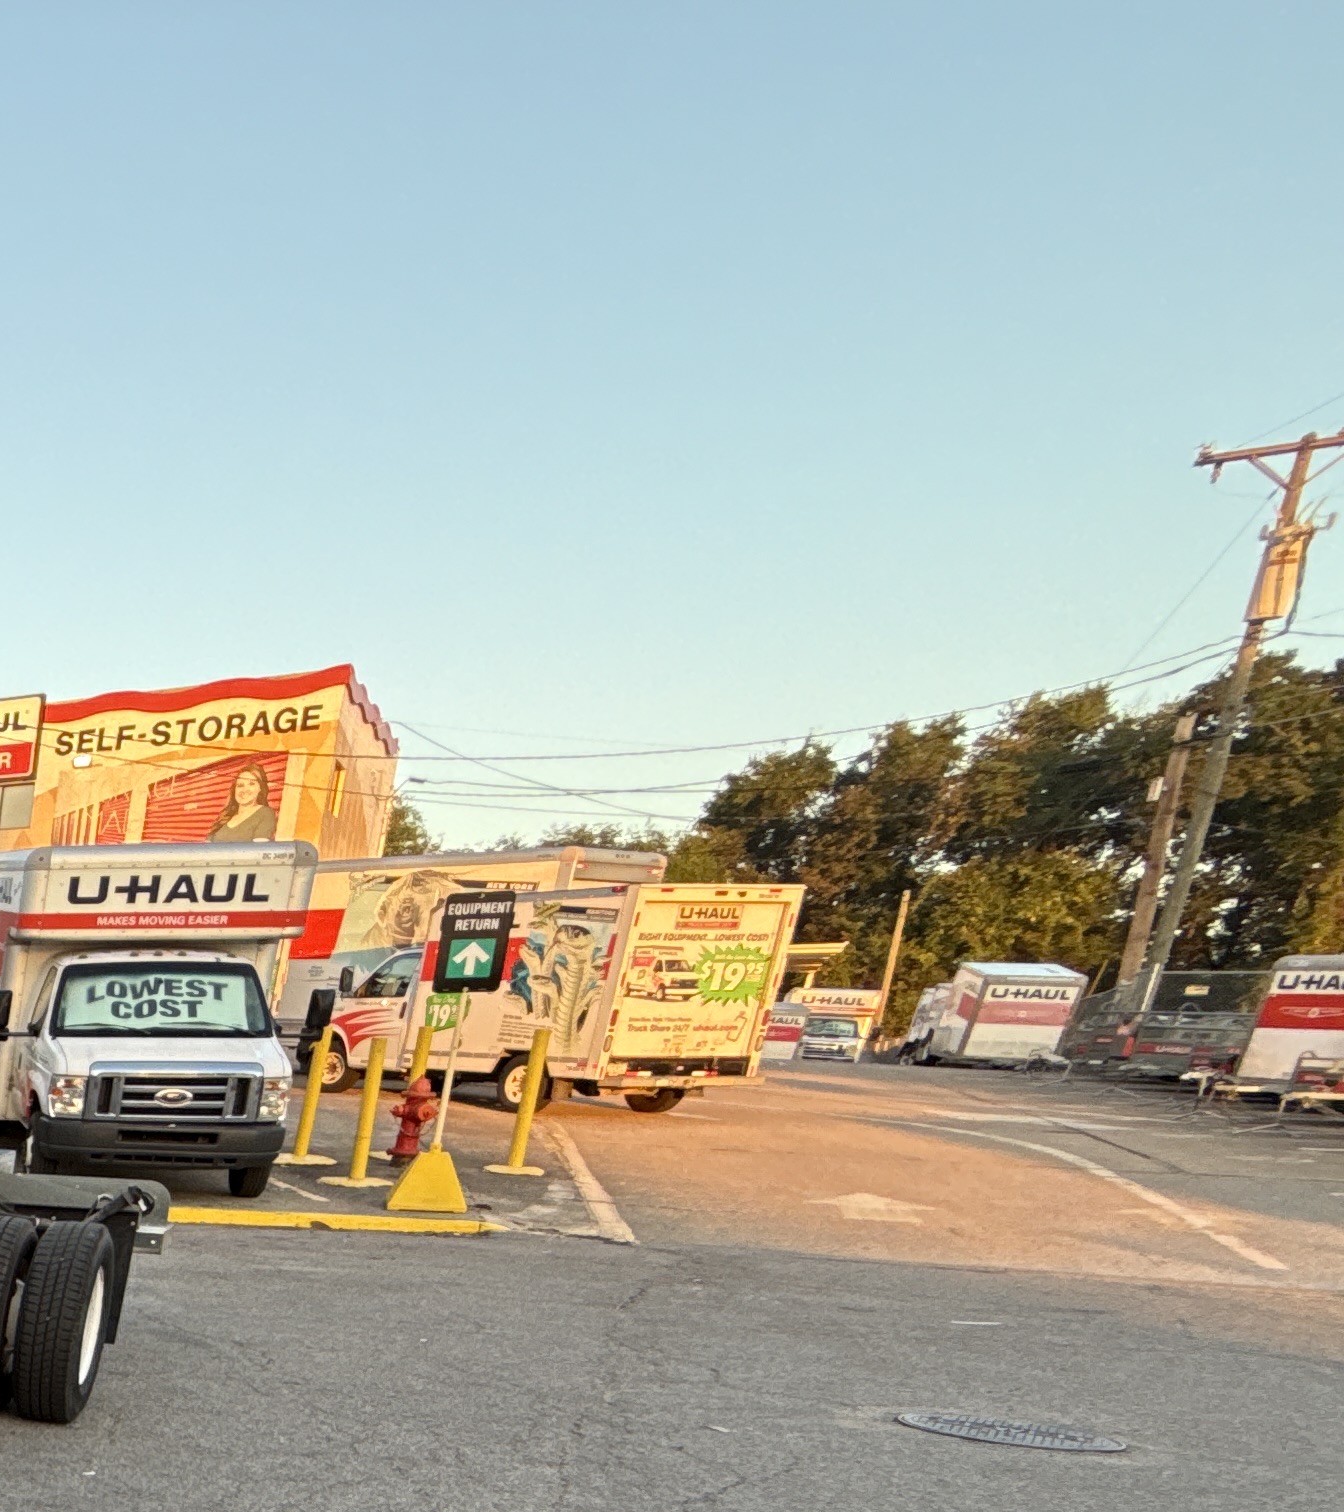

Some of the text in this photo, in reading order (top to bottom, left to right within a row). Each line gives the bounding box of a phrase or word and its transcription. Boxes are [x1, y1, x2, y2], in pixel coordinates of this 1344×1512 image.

[55, 705, 324, 756] SELF-STORAGE
[67, 873, 270, 904] U-HAUL
[447, 901, 513, 916] EQUIPMENT
[680, 907, 740, 919] U-HAUL
[96, 915, 229, 926] MAKES MOVING EASIER
[454, 918, 501, 931] RETURN
[86, 977, 229, 1004] LOWEST
[991, 986, 1071, 1001] U-HAUL
[801, 995, 866, 1006] U-HAUL
[111, 999, 203, 1019] COST
